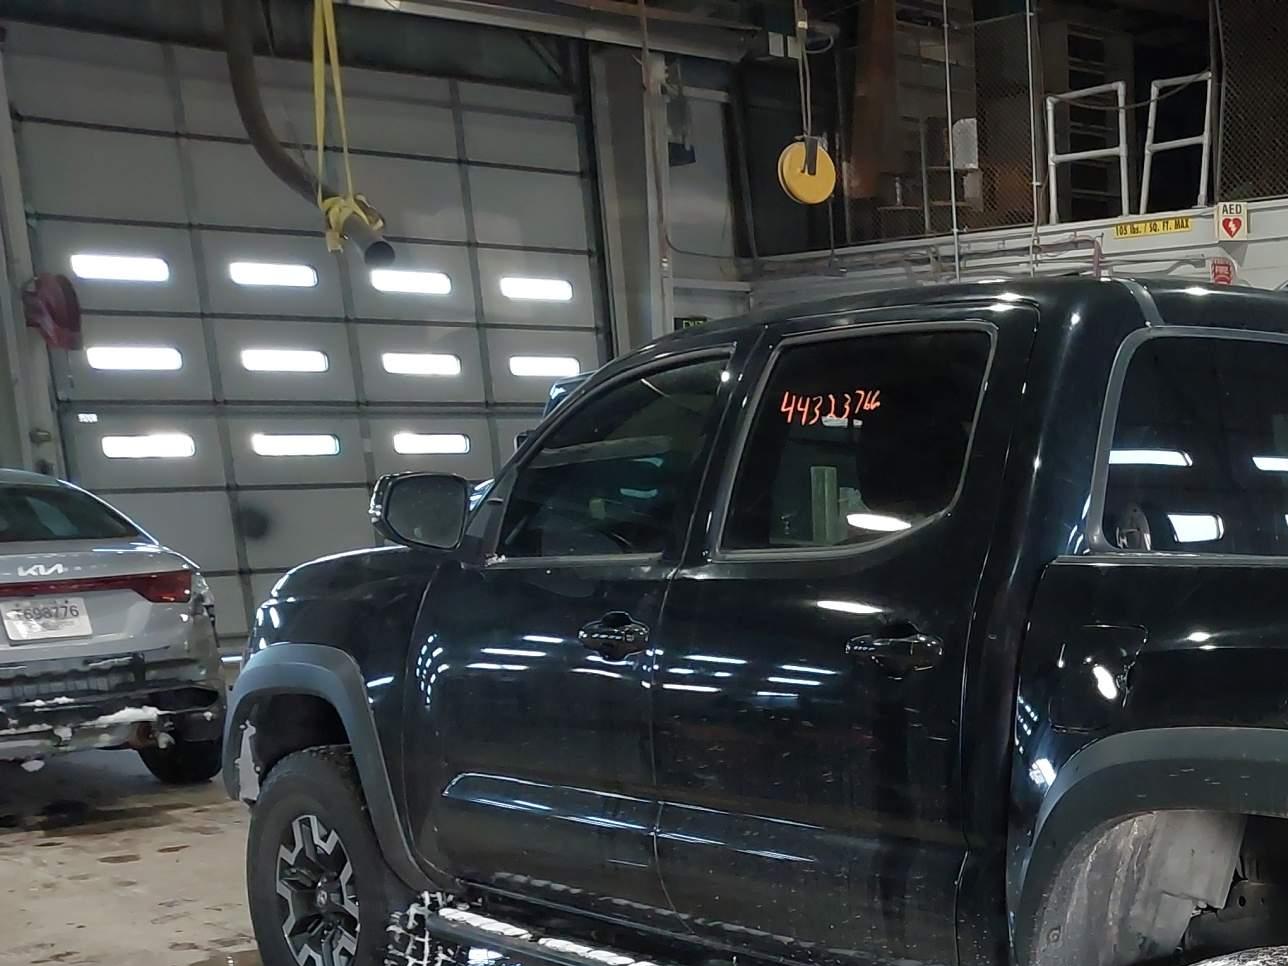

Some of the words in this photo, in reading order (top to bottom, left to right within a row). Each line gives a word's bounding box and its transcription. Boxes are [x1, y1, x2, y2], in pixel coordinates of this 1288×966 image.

[1222, 203, 1242, 215] AED
[1174, 218, 1190, 230] MAX
[780, 389, 882, 426] 44323766
